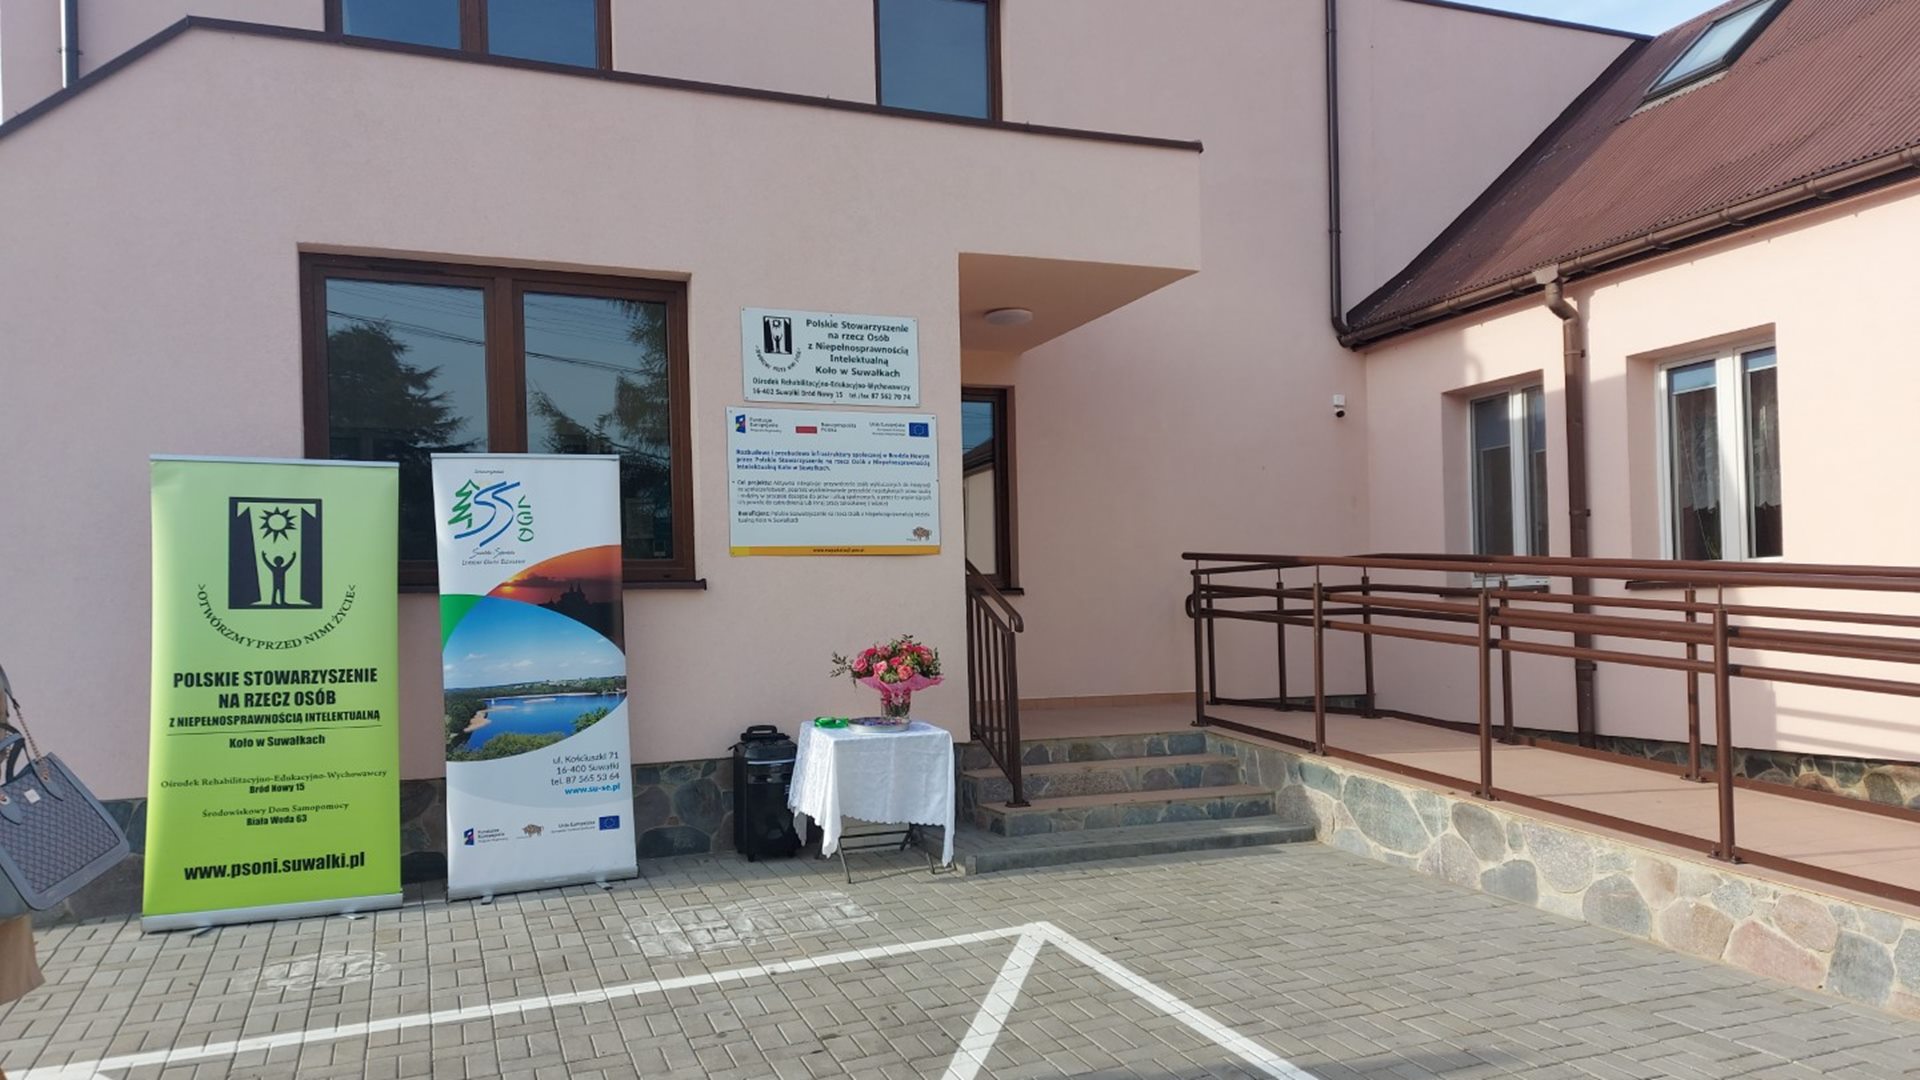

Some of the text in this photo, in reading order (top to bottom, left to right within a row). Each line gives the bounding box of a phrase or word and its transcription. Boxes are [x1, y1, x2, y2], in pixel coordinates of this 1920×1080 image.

[806, 320, 909, 332] Polskie Stowarzyszenie
[867, 333, 890, 342] Osób
[815, 342, 909, 355] Niepełnosprawnością
[830, 355, 888, 366] Intelektualną
[815, 366, 836, 375] Koło
[851, 368, 900, 377] Suwałkach
[197, 590, 356, 650] OTWÓRZMY PRZED NIMI ŻYCIE
[173, 668, 378, 688] POLSKIE STOWARZYSZENIE
[219, 688, 336, 709] NA RZECZ OSÓB
[169, 710, 380, 727] Z NIEPEŁNOSPRAWNOŚCIĄ INTELEKTUALNĄ
[230, 734, 326, 748] Koło w Suwałkach
[553, 756, 563, 764] ul.
[565, 753, 607, 763] Kościuszki
[557, 762, 619, 775] 16-400 Suwałki
[161, 771, 387, 788] Ośrodek Rehabilitacyjno-Edukacyjno-Wychowawczy
[566, 776, 576, 784] 87
[609, 772, 620, 780] 64
[249, 782, 305, 794] Bród Nowy 15
[565, 783, 621, 795] www.su-se.pl
[202, 803, 349, 817] Środowiskowy Dom Samopomocy
[246, 814, 307, 826] Biała Woda 63
[184, 852, 365, 880] www.psoni.suwalki.pl
